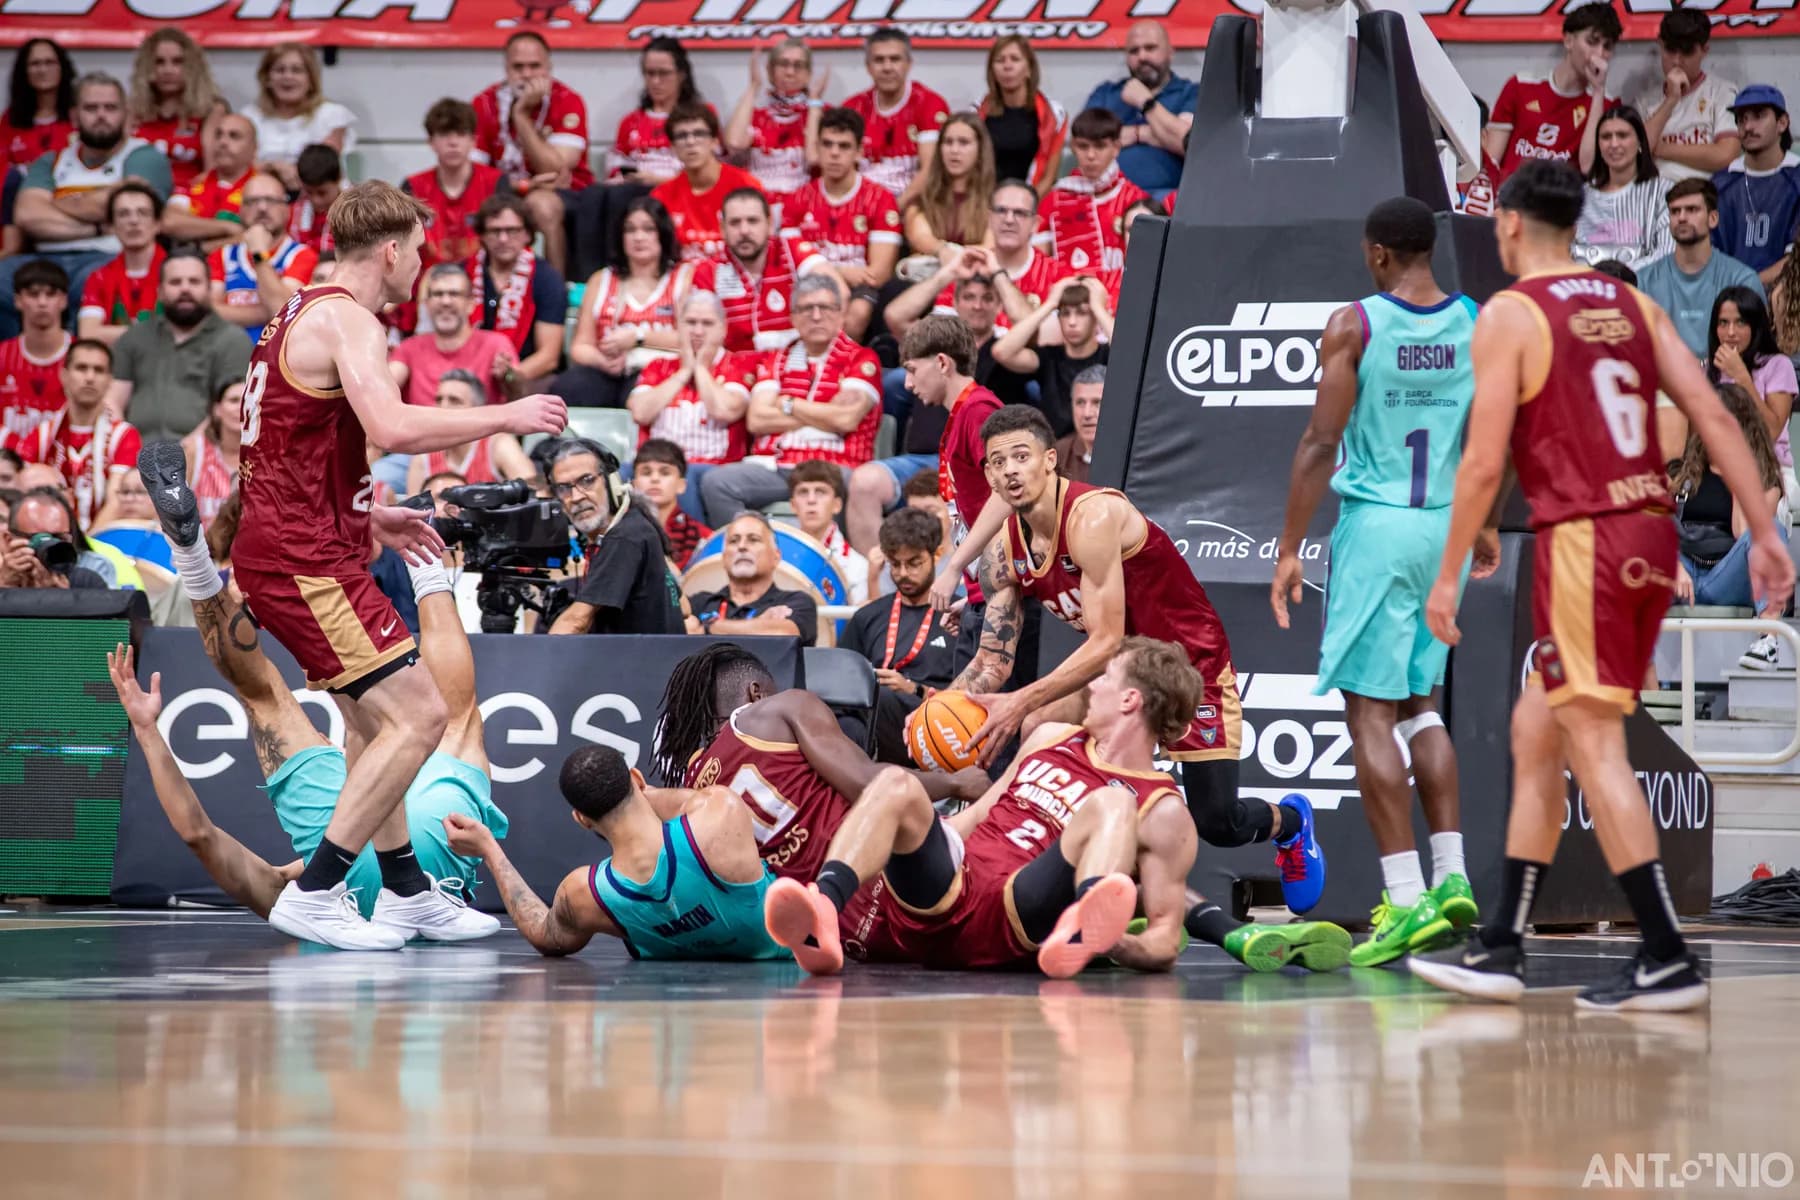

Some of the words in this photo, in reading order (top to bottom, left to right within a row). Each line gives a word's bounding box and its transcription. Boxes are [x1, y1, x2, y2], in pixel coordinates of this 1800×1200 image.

[1397, 343, 1456, 371] GIBSON
[1405, 399, 1459, 408] FOUNDATION
[1591, 357, 1649, 458] 6
[1405, 428, 1430, 508] 1
[1197, 536, 1250, 559] más
[1299, 538, 1322, 560] la
[1634, 770, 1709, 830] YOND
[1005, 819, 1048, 850] 2
